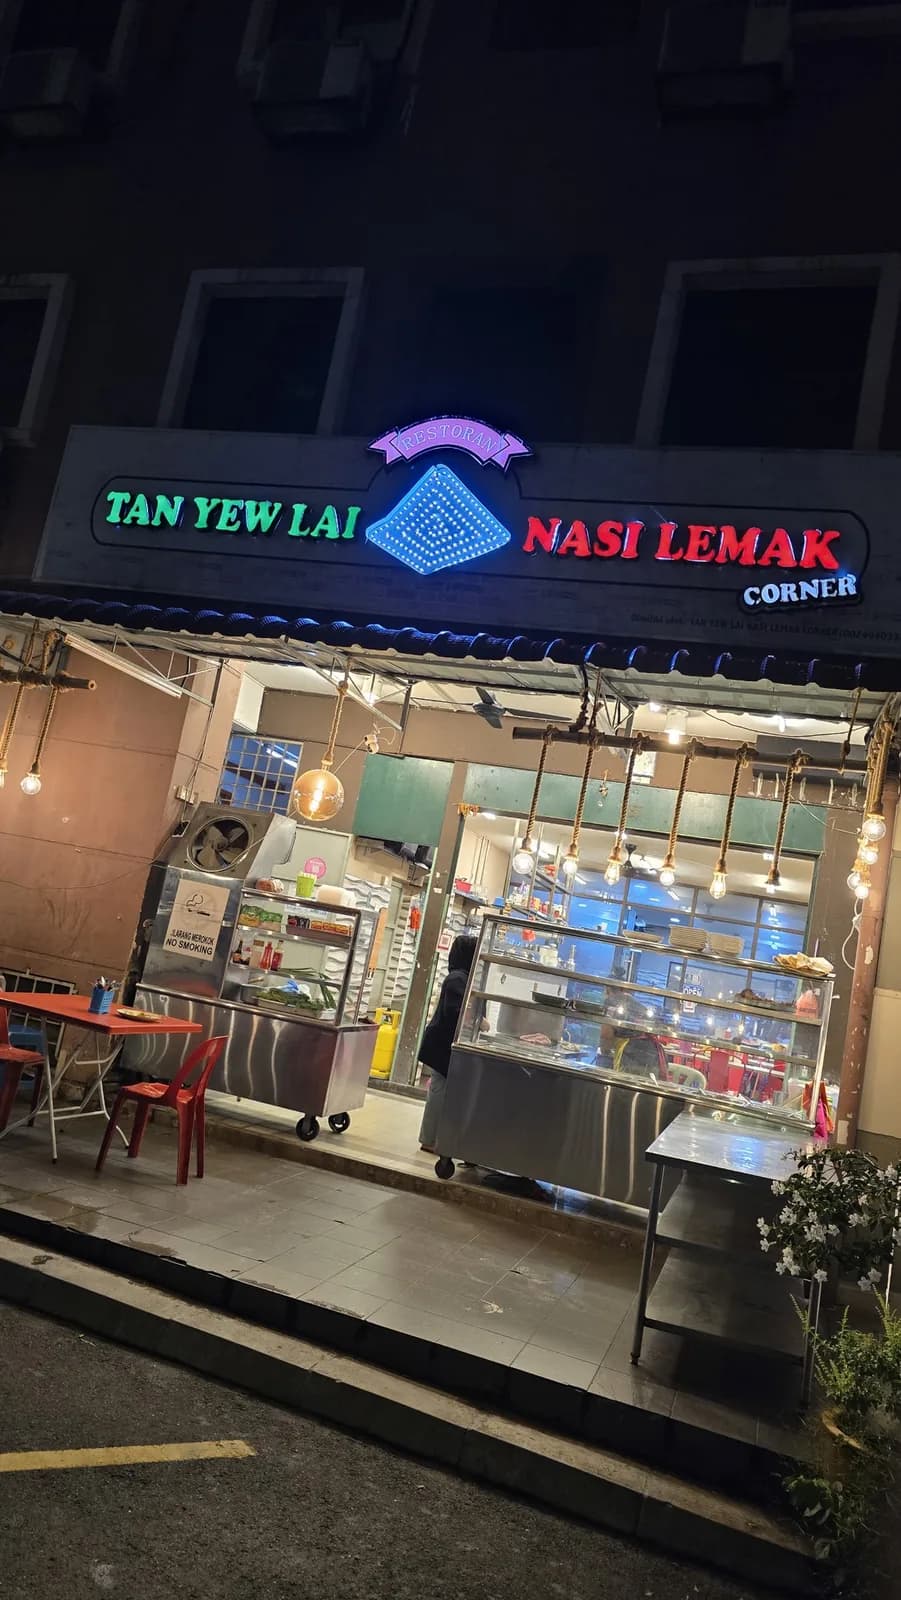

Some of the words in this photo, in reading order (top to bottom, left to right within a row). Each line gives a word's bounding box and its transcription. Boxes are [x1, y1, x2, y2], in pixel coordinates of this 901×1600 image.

[400, 423, 497, 452] RESTORAN
[106, 491, 184, 526] TAN
[194, 497, 282, 532] YEW
[288, 503, 361, 539] LAI
[522, 516, 645, 559] NASI
[654, 521, 840, 570] LEMAK
[743, 573, 857, 606] CORNER
[166, 938, 178, 947] NO
[178, 940, 213, 955] SMOKING
